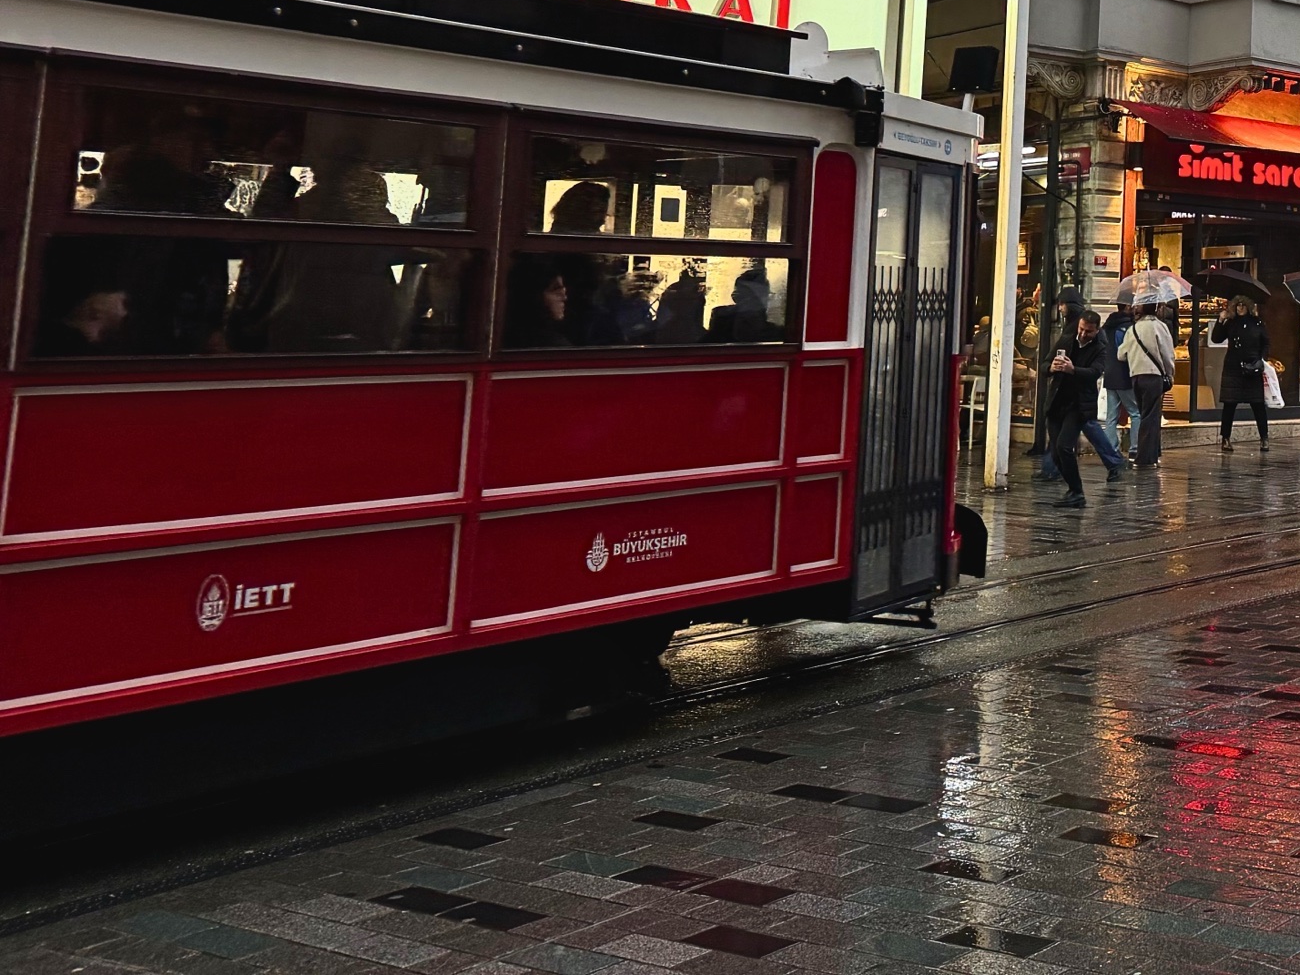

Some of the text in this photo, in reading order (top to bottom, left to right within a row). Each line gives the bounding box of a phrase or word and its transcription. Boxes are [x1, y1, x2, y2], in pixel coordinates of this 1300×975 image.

[1178, 144, 1244, 183] simit
[613, 531, 688, 556] BÜYÜKŞEHİR
[234, 583, 295, 611] İETT
